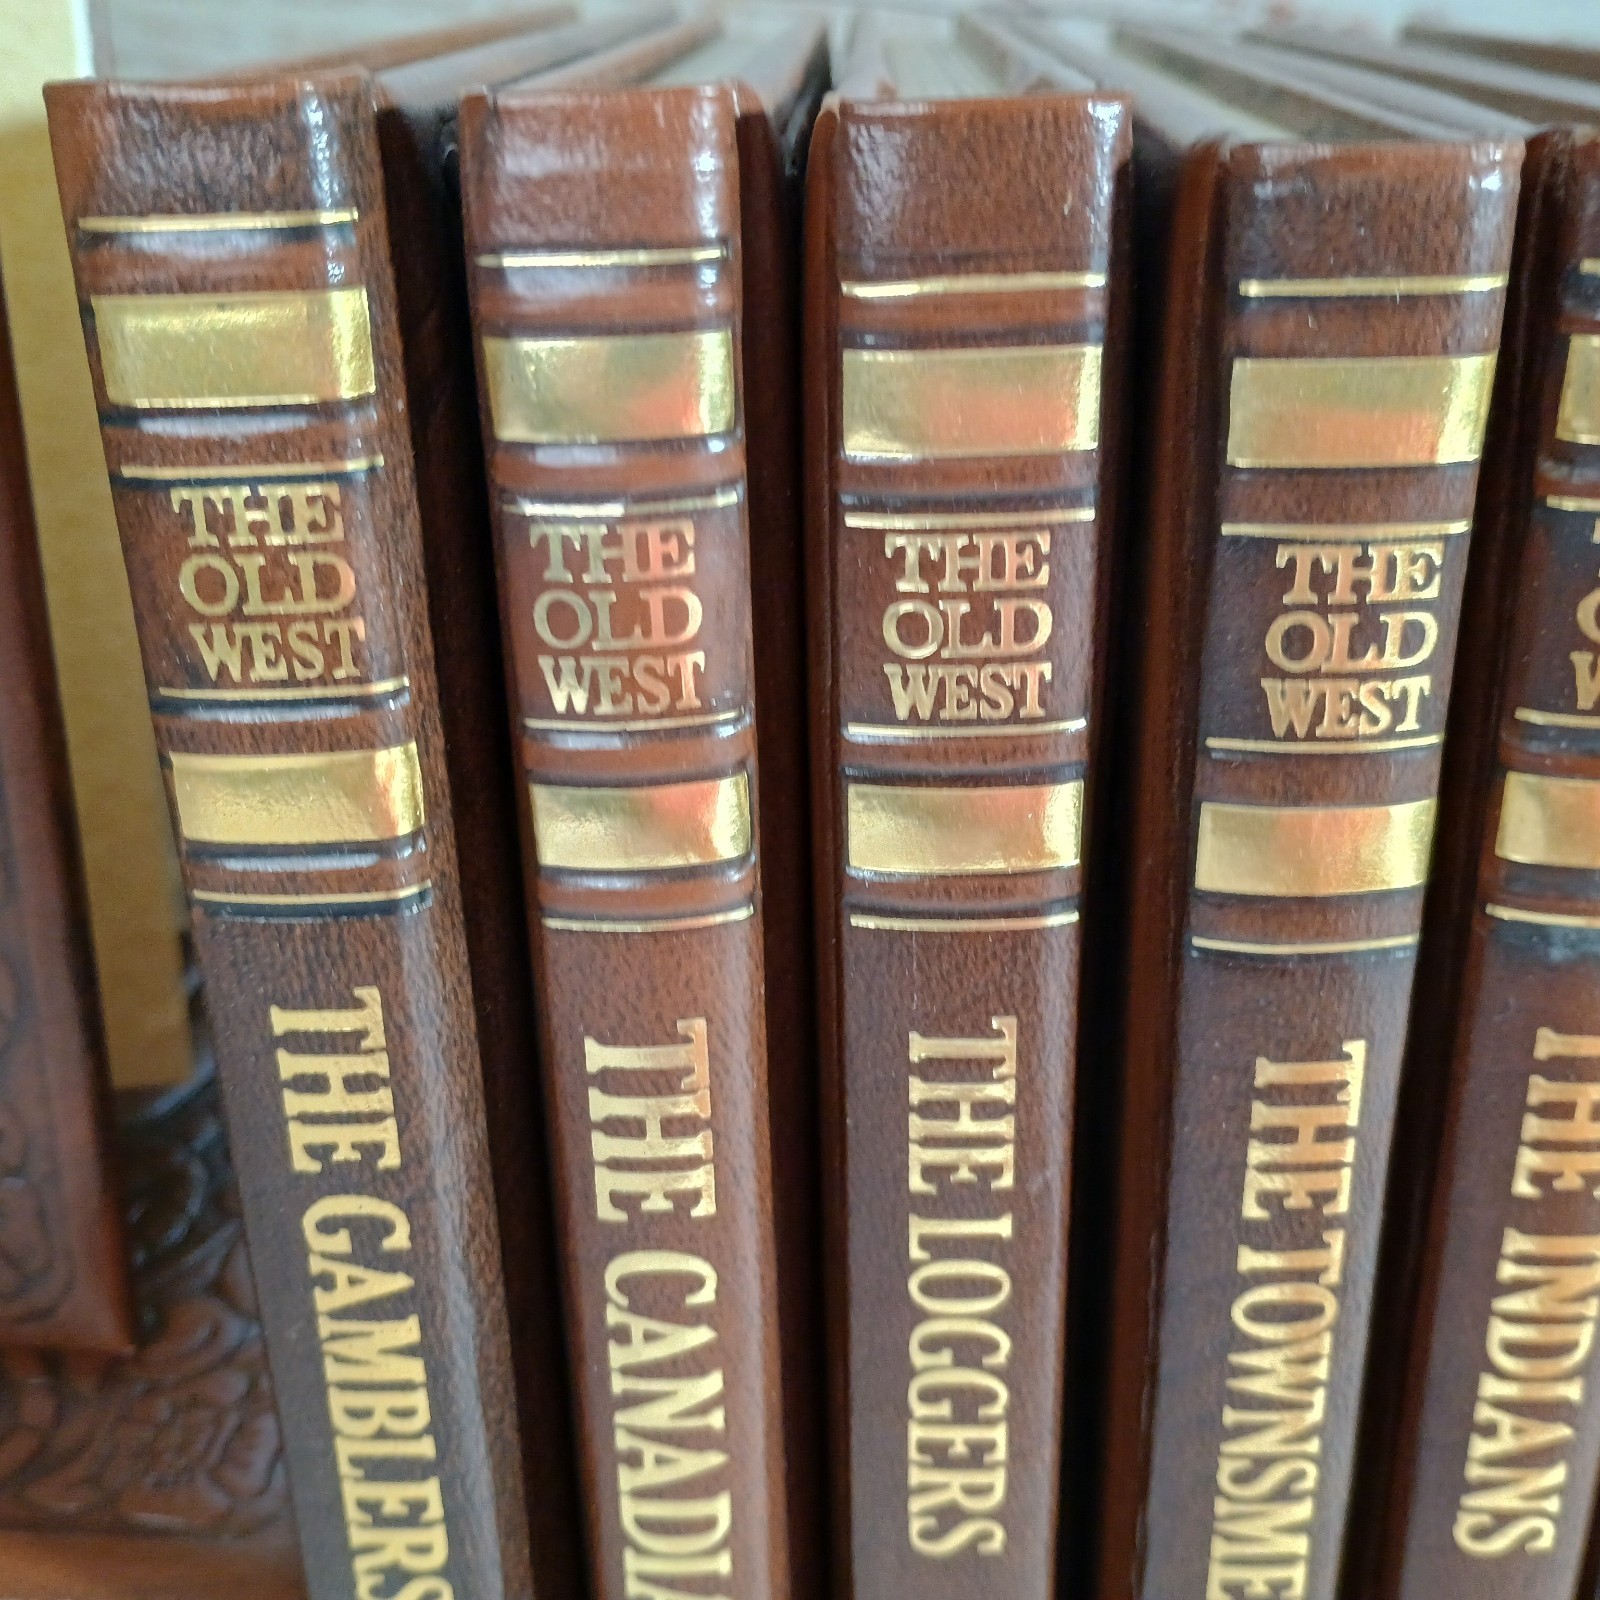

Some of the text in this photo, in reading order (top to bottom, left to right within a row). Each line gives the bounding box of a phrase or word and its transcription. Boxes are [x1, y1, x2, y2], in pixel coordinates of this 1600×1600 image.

[171, 483, 344, 547] THE
[178, 549, 357, 618] OLD
[529, 519, 697, 585] THE
[883, 530, 1051, 594] THE
[1275, 541, 1443, 606] THE
[189, 617, 366, 682] WEST
[532, 588, 704, 651] OLD
[882, 598, 1053, 660] OLD
[1264, 609, 1440, 674] OLD
[537, 651, 706, 717] WEST
[883, 661, 1053, 722] WEST
[1260, 675, 1432, 740] WEST
[269, 985, 402, 1174] THE
[584, 1017, 717, 1223] THE
[1241, 1038, 1368, 1222] THE
[907, 1015, 1018, 1558] THE LOGGERS
[1452, 1227, 1600, 1558] INDIANS
